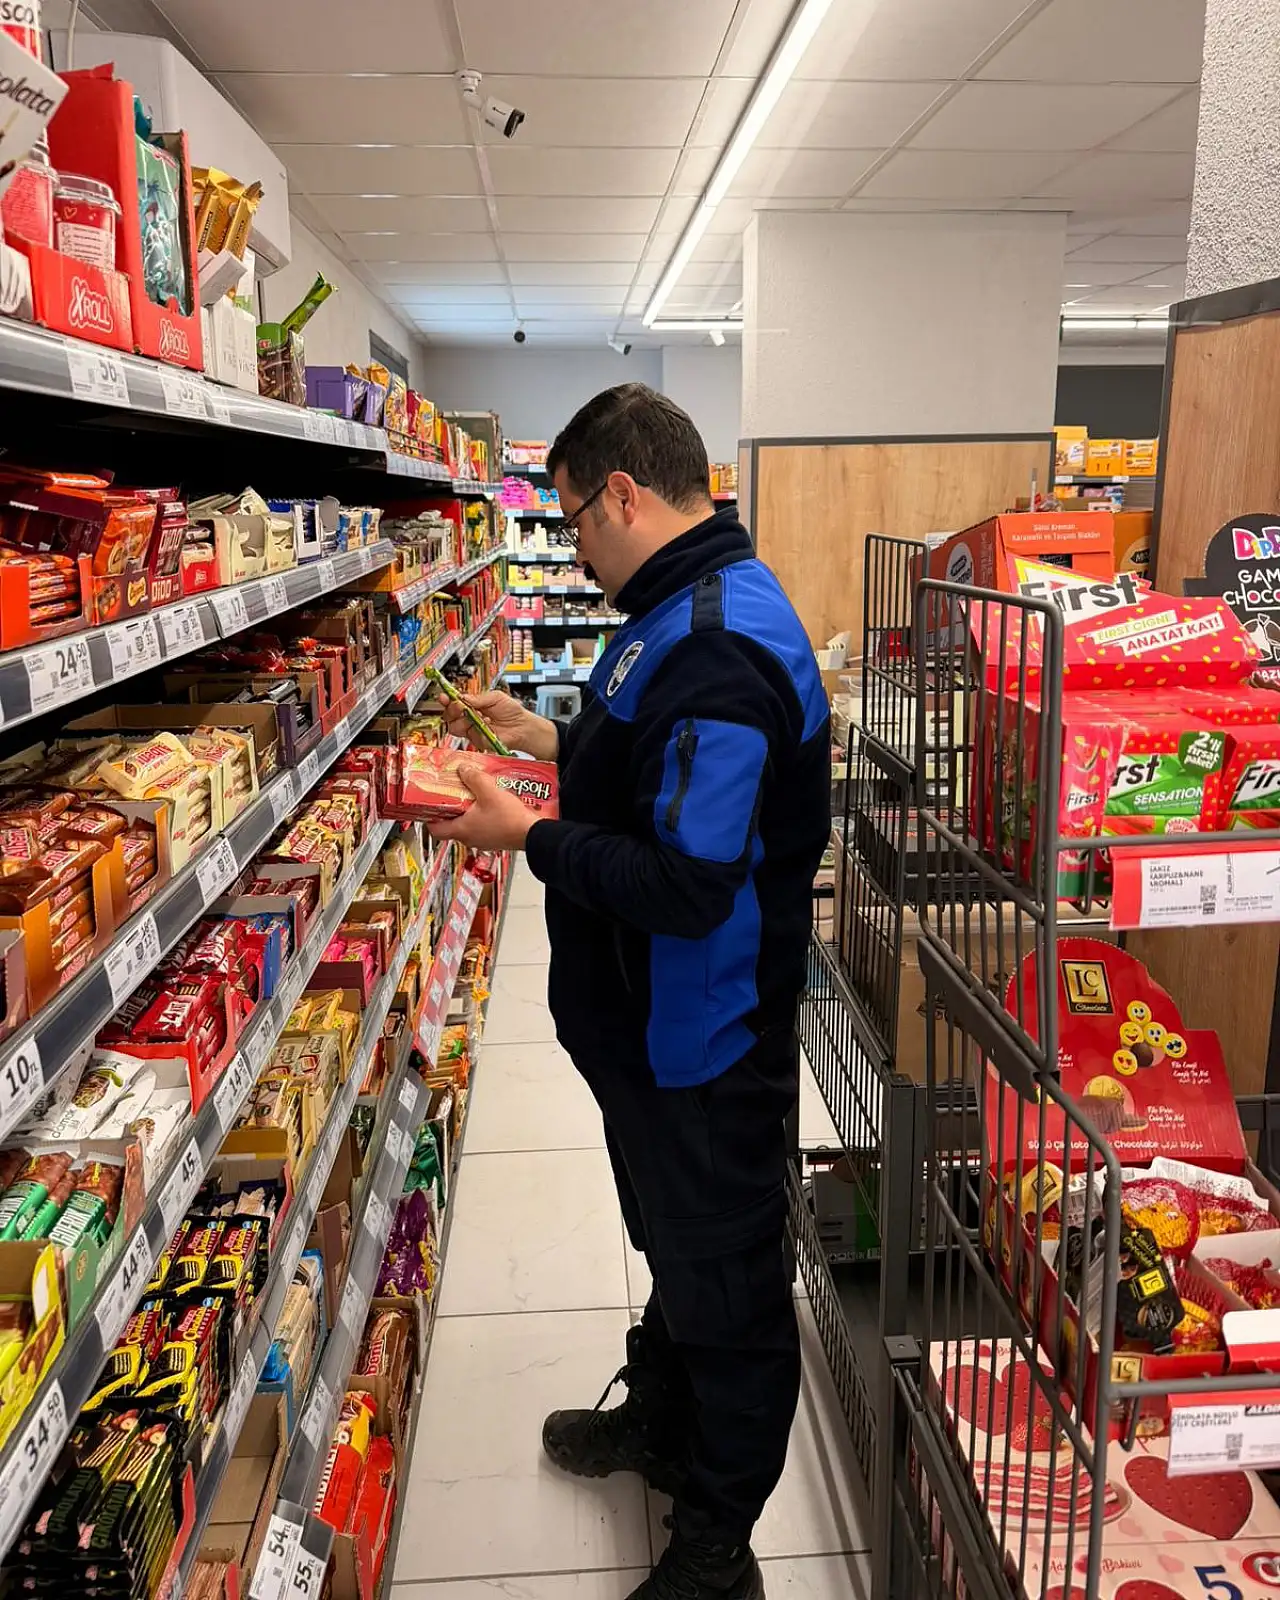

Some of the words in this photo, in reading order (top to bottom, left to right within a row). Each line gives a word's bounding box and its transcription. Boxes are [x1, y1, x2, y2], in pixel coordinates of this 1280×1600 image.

[1237, 764, 1280, 792] Fir
[6, 1055, 30, 1098] 10
[268, 1529, 289, 1557] 54
[293, 1561, 312, 1594] 55
